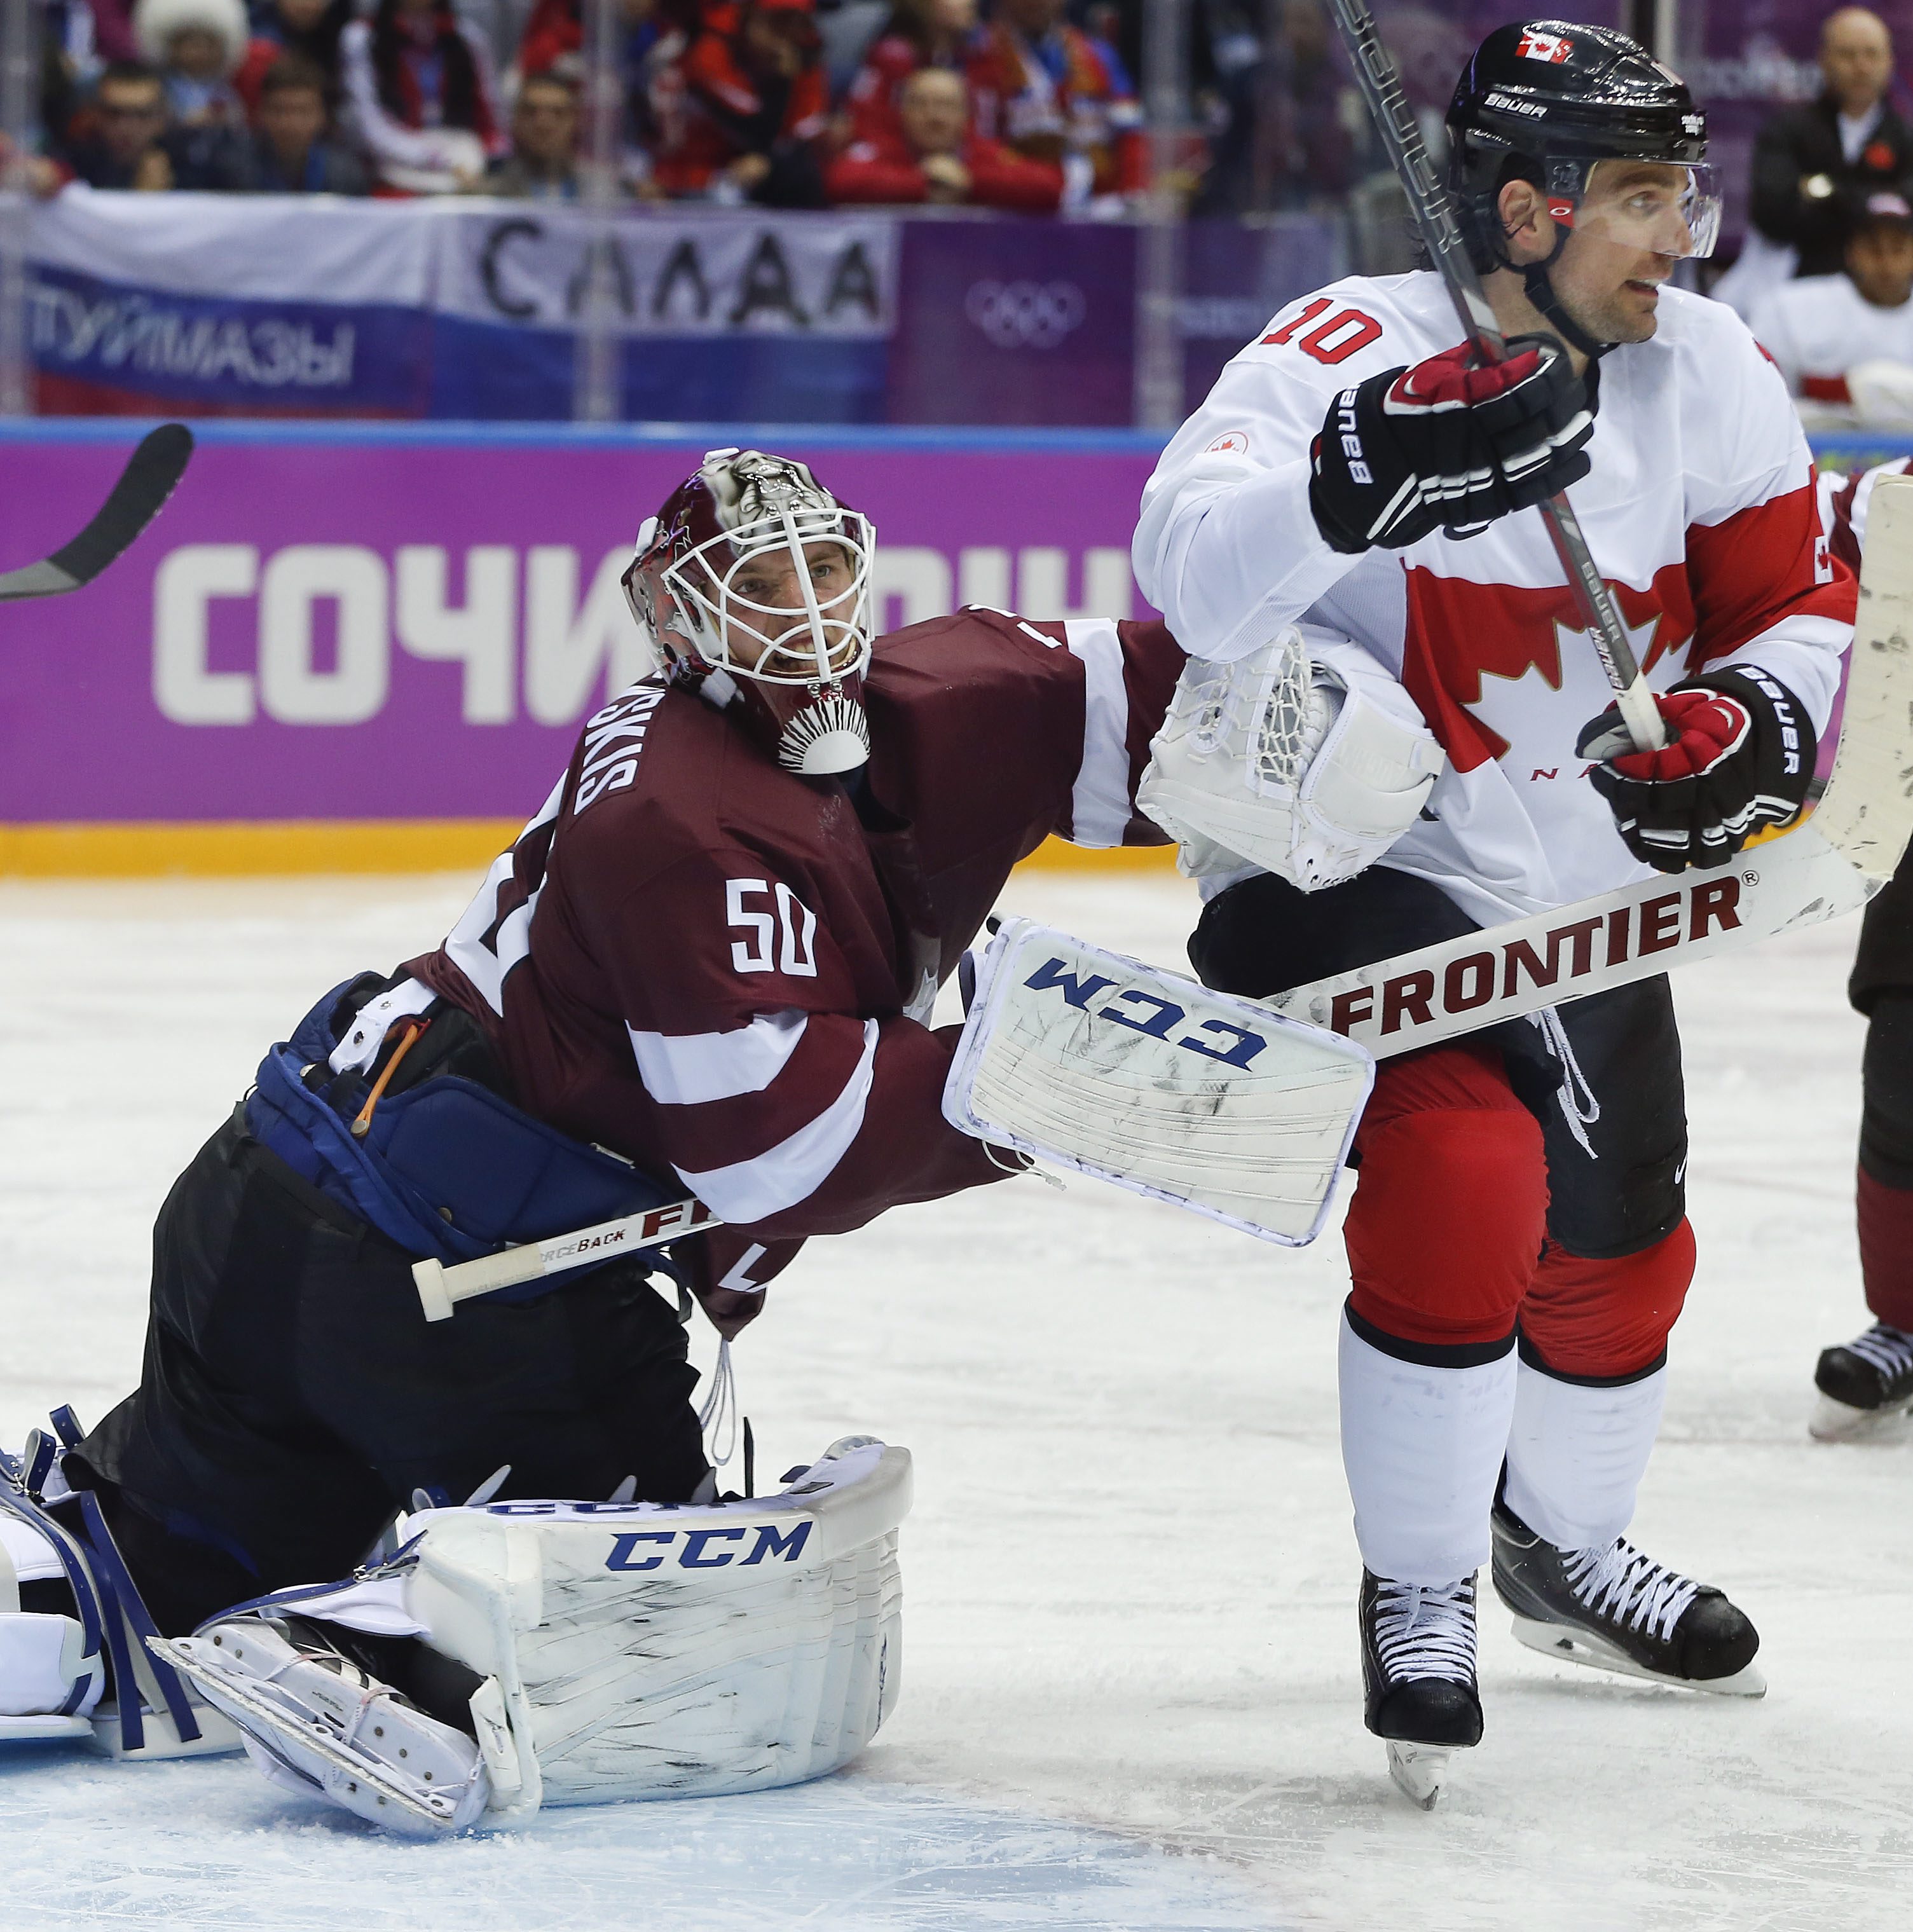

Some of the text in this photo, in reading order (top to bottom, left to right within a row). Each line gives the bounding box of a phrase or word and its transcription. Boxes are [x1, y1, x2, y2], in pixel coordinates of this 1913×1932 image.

[1484, 93, 1548, 118] BAUER
[30, 281, 356, 387] ТУЙМАЗЫ
[1258, 298, 1383, 366] 10
[1337, 383, 1375, 484] BAUE
[152, 544, 656, 727] СОЧИ
[1580, 561, 1621, 643] BAUER
[1734, 666, 1800, 775] BAUER
[725, 877, 818, 978] 50
[1024, 957, 1268, 1073] CCM
[605, 1520, 814, 1572] CCM
